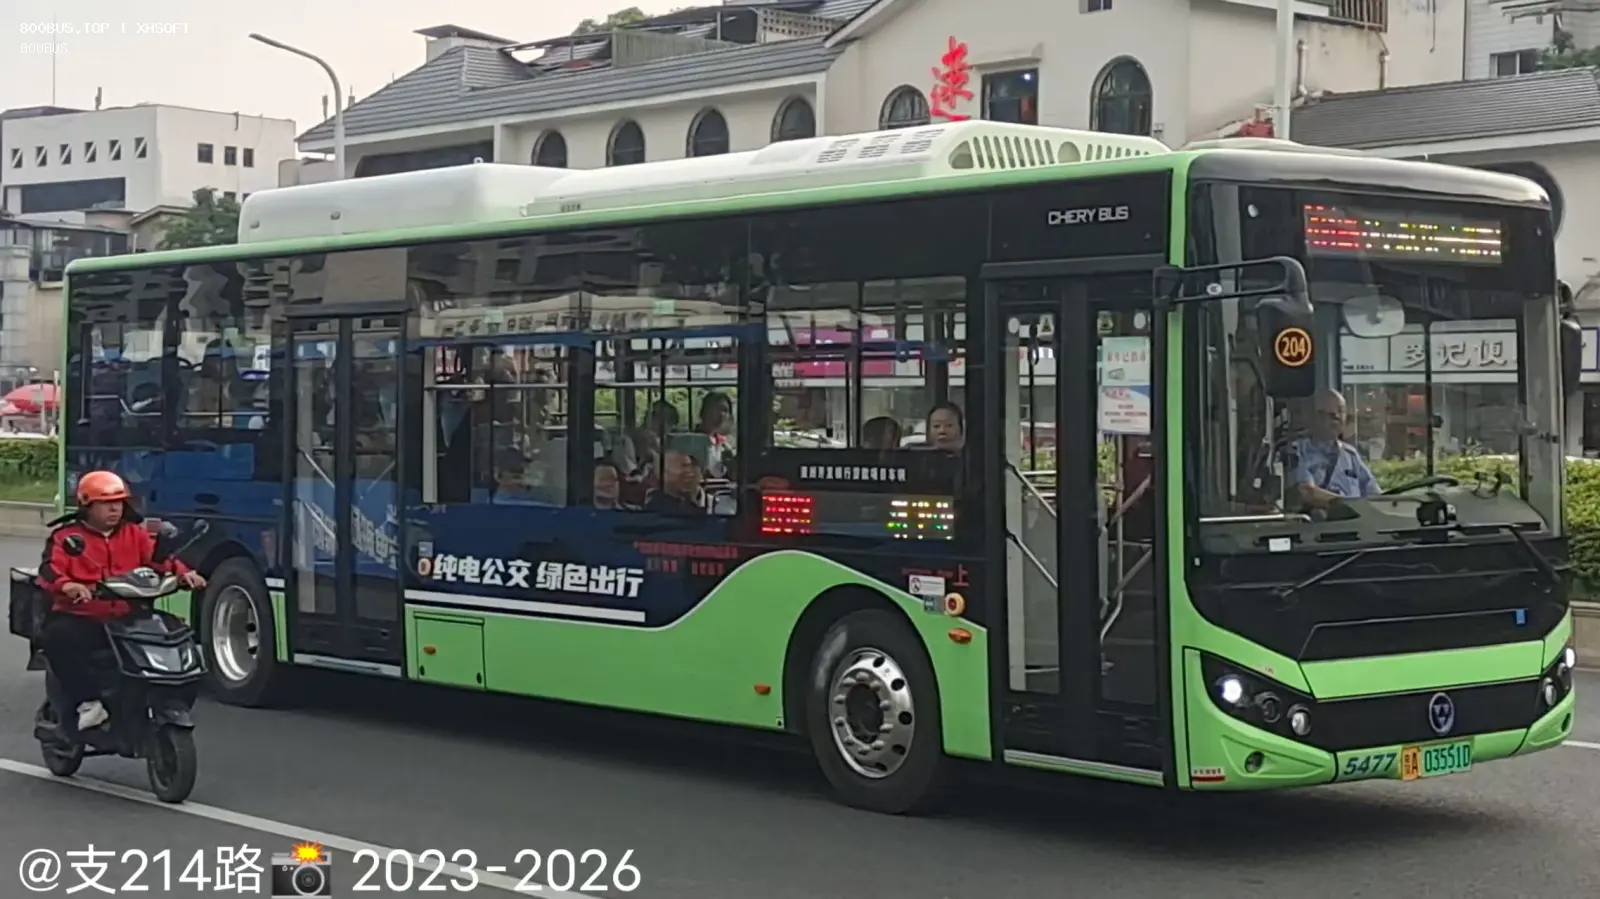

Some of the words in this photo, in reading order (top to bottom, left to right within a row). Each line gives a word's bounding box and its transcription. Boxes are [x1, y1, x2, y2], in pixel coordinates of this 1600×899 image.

[1048, 208, 1096, 225] CHERY
[1098, 206, 1129, 221] BUS
[1282, 336, 1306, 357] 204
[432, 553, 532, 588] 纯电公交
[535, 561, 644, 598] 绿色出行
[1343, 752, 1397, 776] 5477
